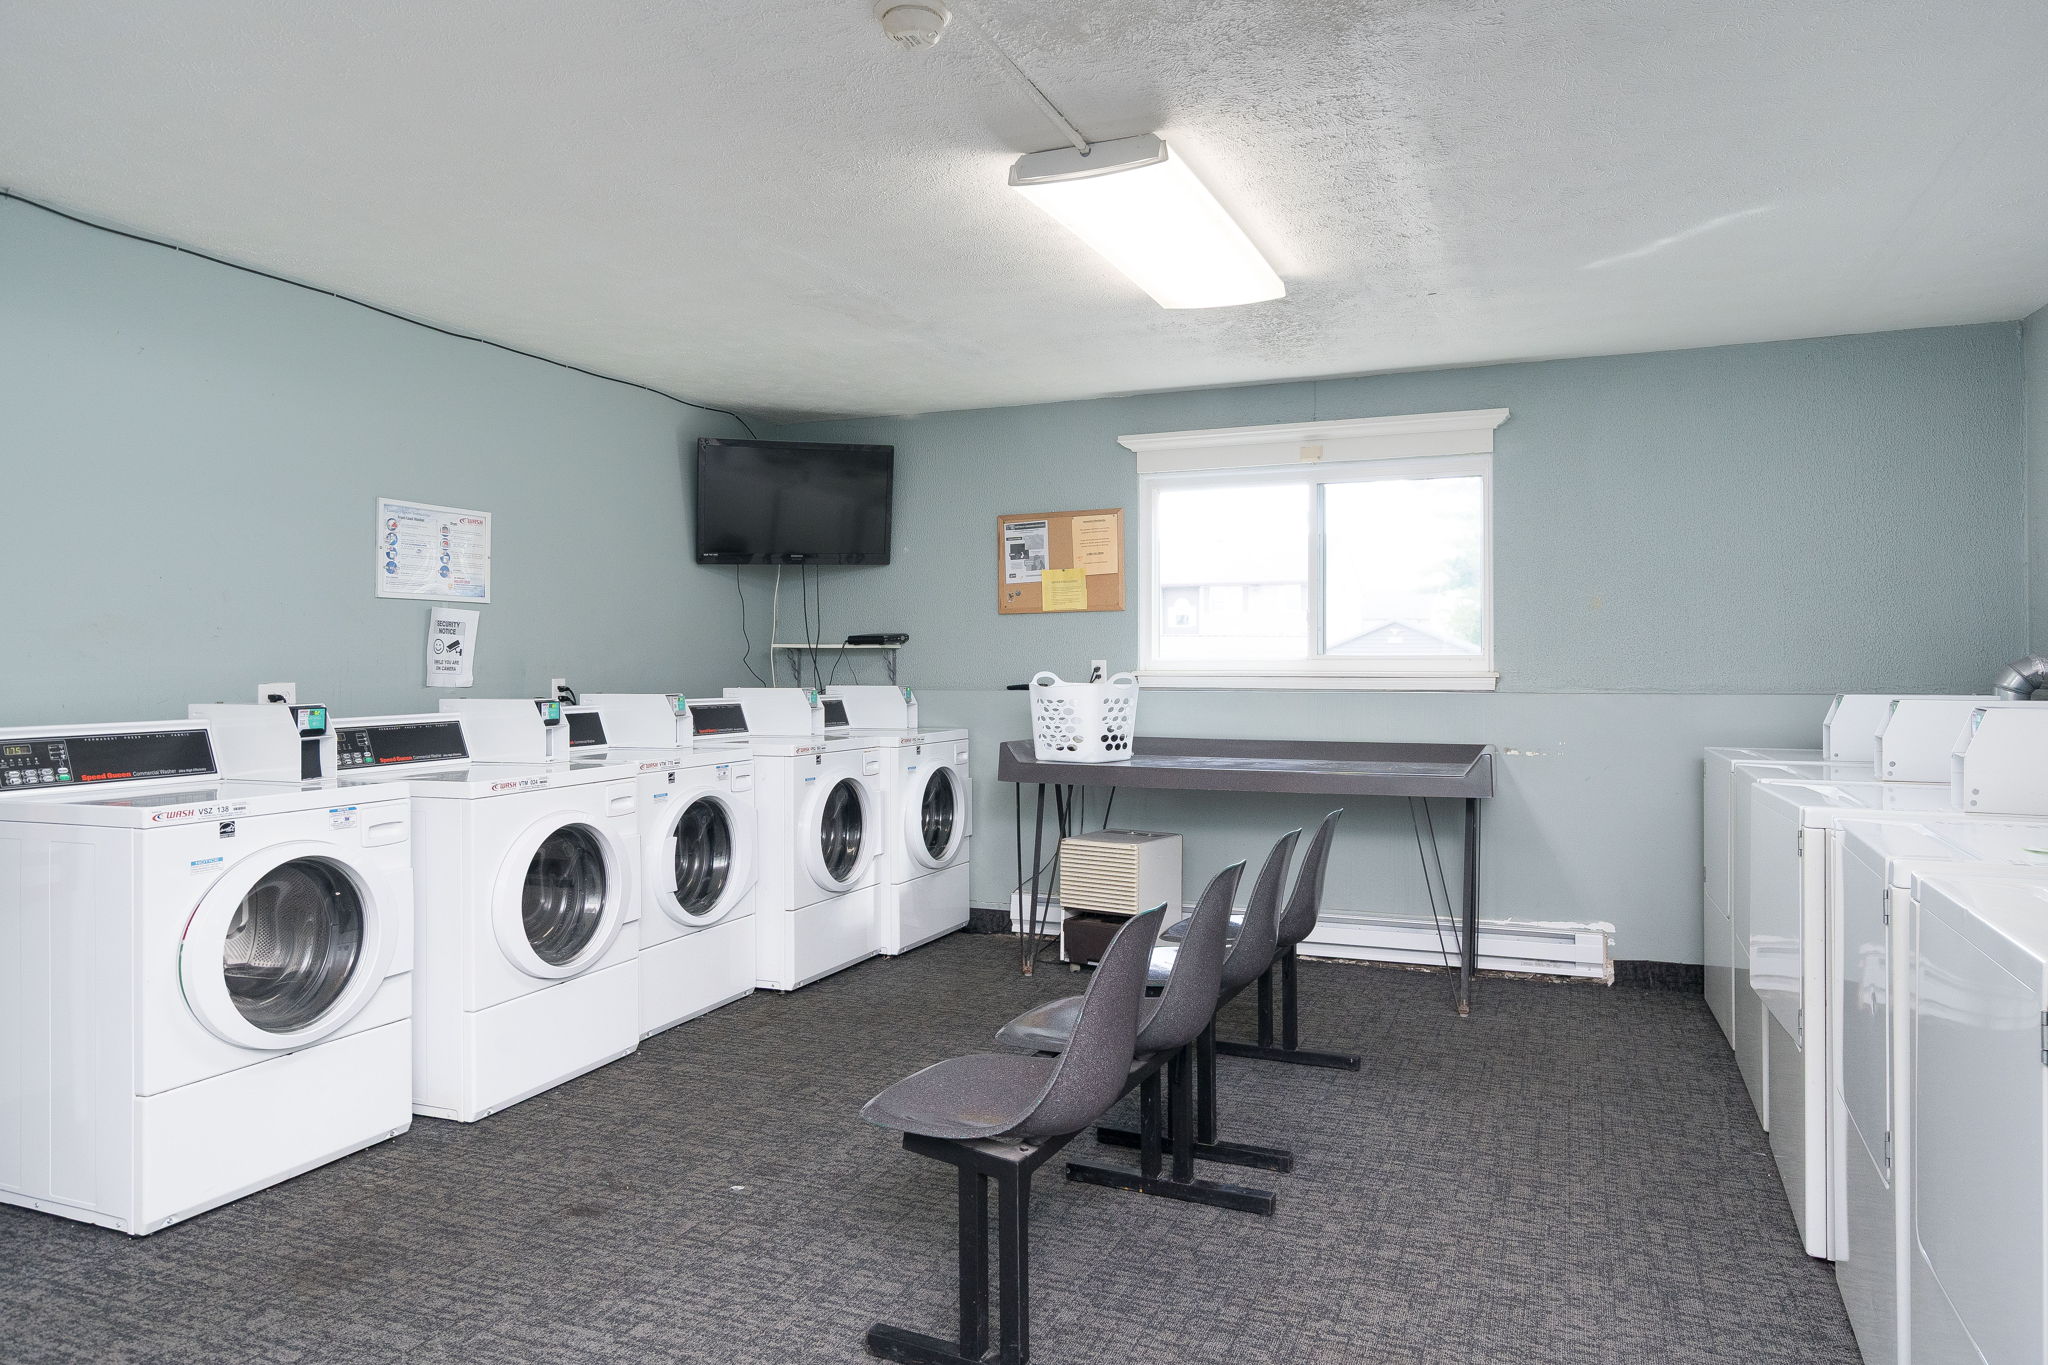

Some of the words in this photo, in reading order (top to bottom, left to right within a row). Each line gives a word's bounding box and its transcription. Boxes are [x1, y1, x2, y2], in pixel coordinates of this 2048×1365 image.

[437, 620, 460, 628] SECURITY
[81, 773, 107, 782] Speed
[166, 809, 195, 819] WASH
[198, 807, 213, 815] VSZ
